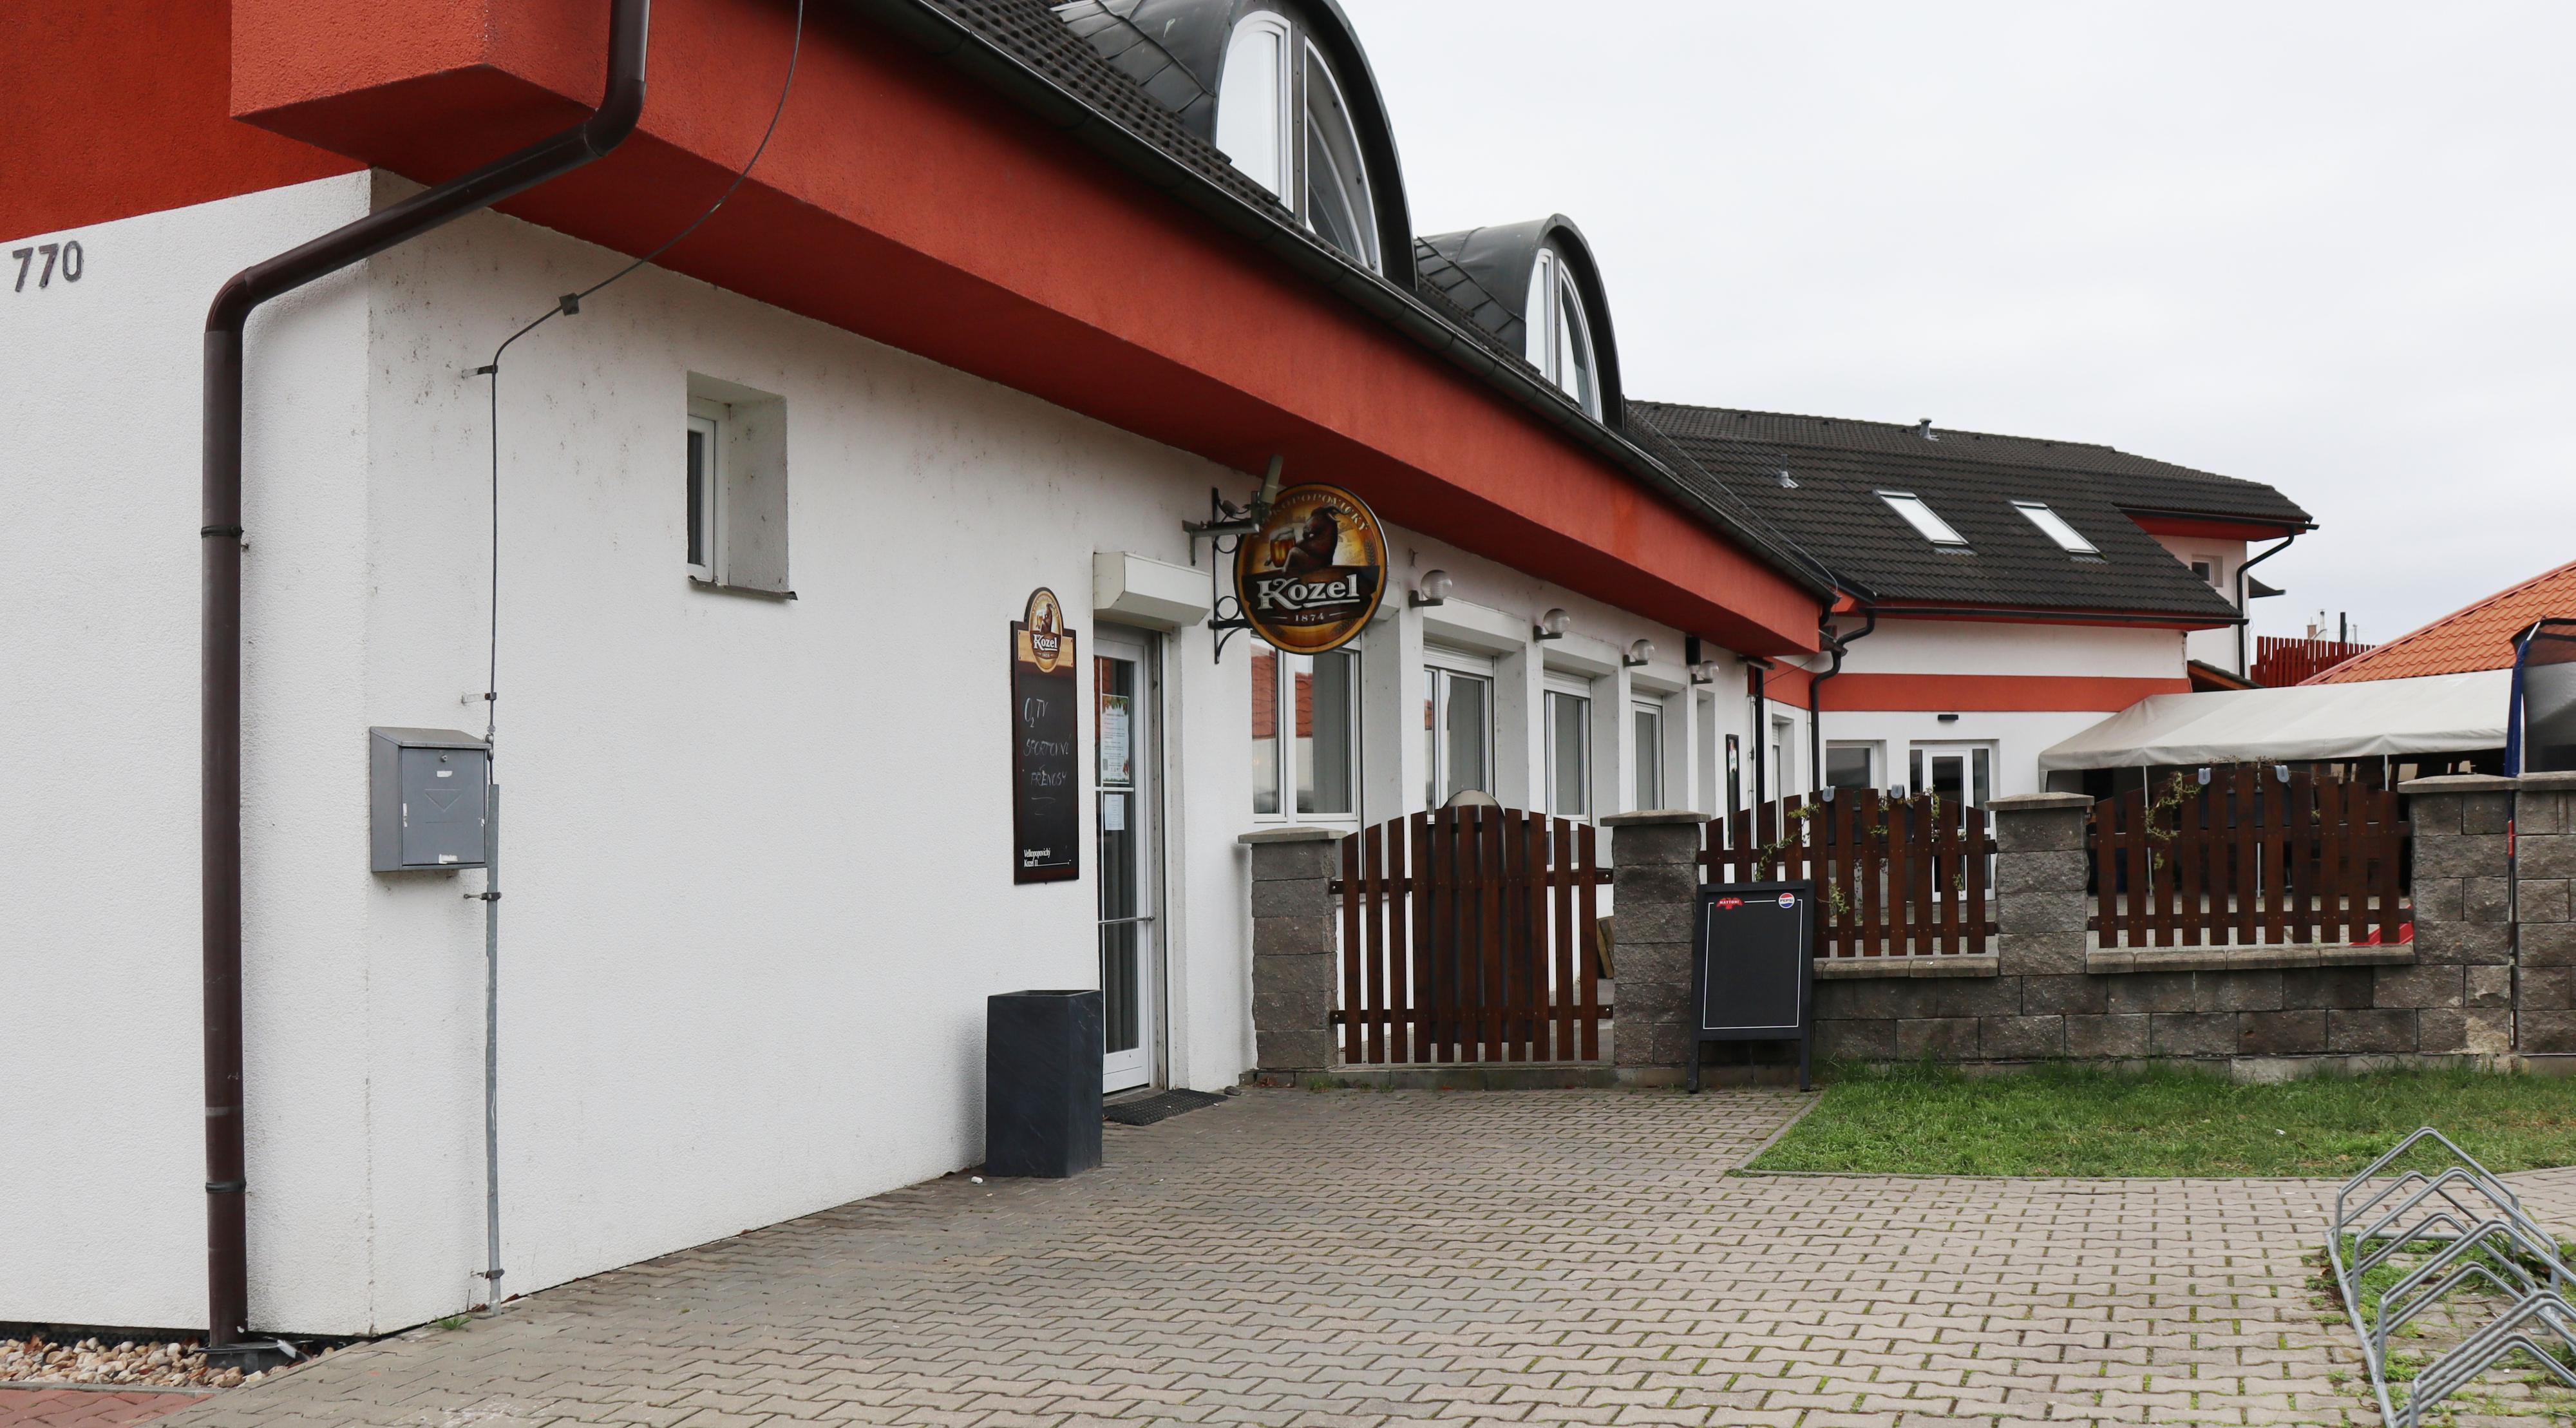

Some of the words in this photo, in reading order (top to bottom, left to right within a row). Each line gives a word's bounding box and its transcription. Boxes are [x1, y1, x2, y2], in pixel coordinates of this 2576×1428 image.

[12, 240, 84, 292] 770
[1257, 573, 1360, 610] Kozel
[1295, 612, 1324, 622] 1874
[1033, 634, 1057, 651] Kozel
